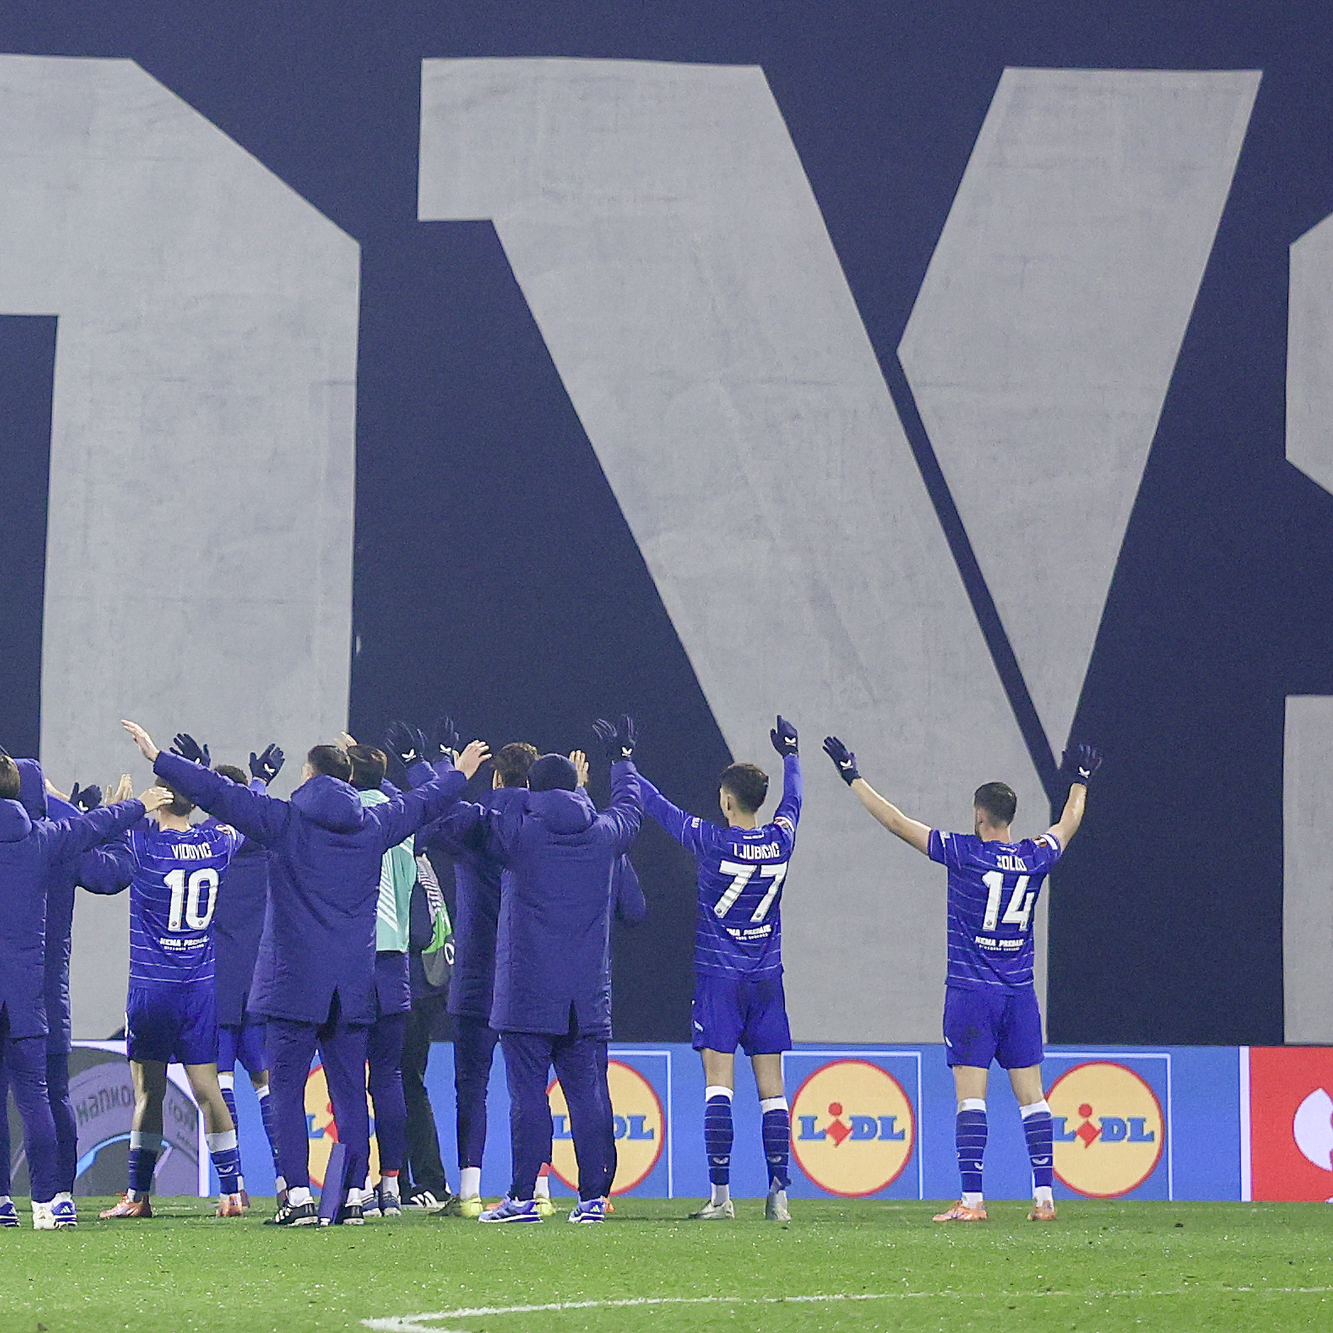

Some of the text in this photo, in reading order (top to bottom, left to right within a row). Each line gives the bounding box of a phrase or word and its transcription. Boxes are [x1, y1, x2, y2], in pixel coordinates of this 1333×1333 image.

[163, 867, 220, 932] 10
[713, 859, 788, 922] 77
[981, 870, 1035, 932] 14
[551, 1114, 655, 1141] LDL
